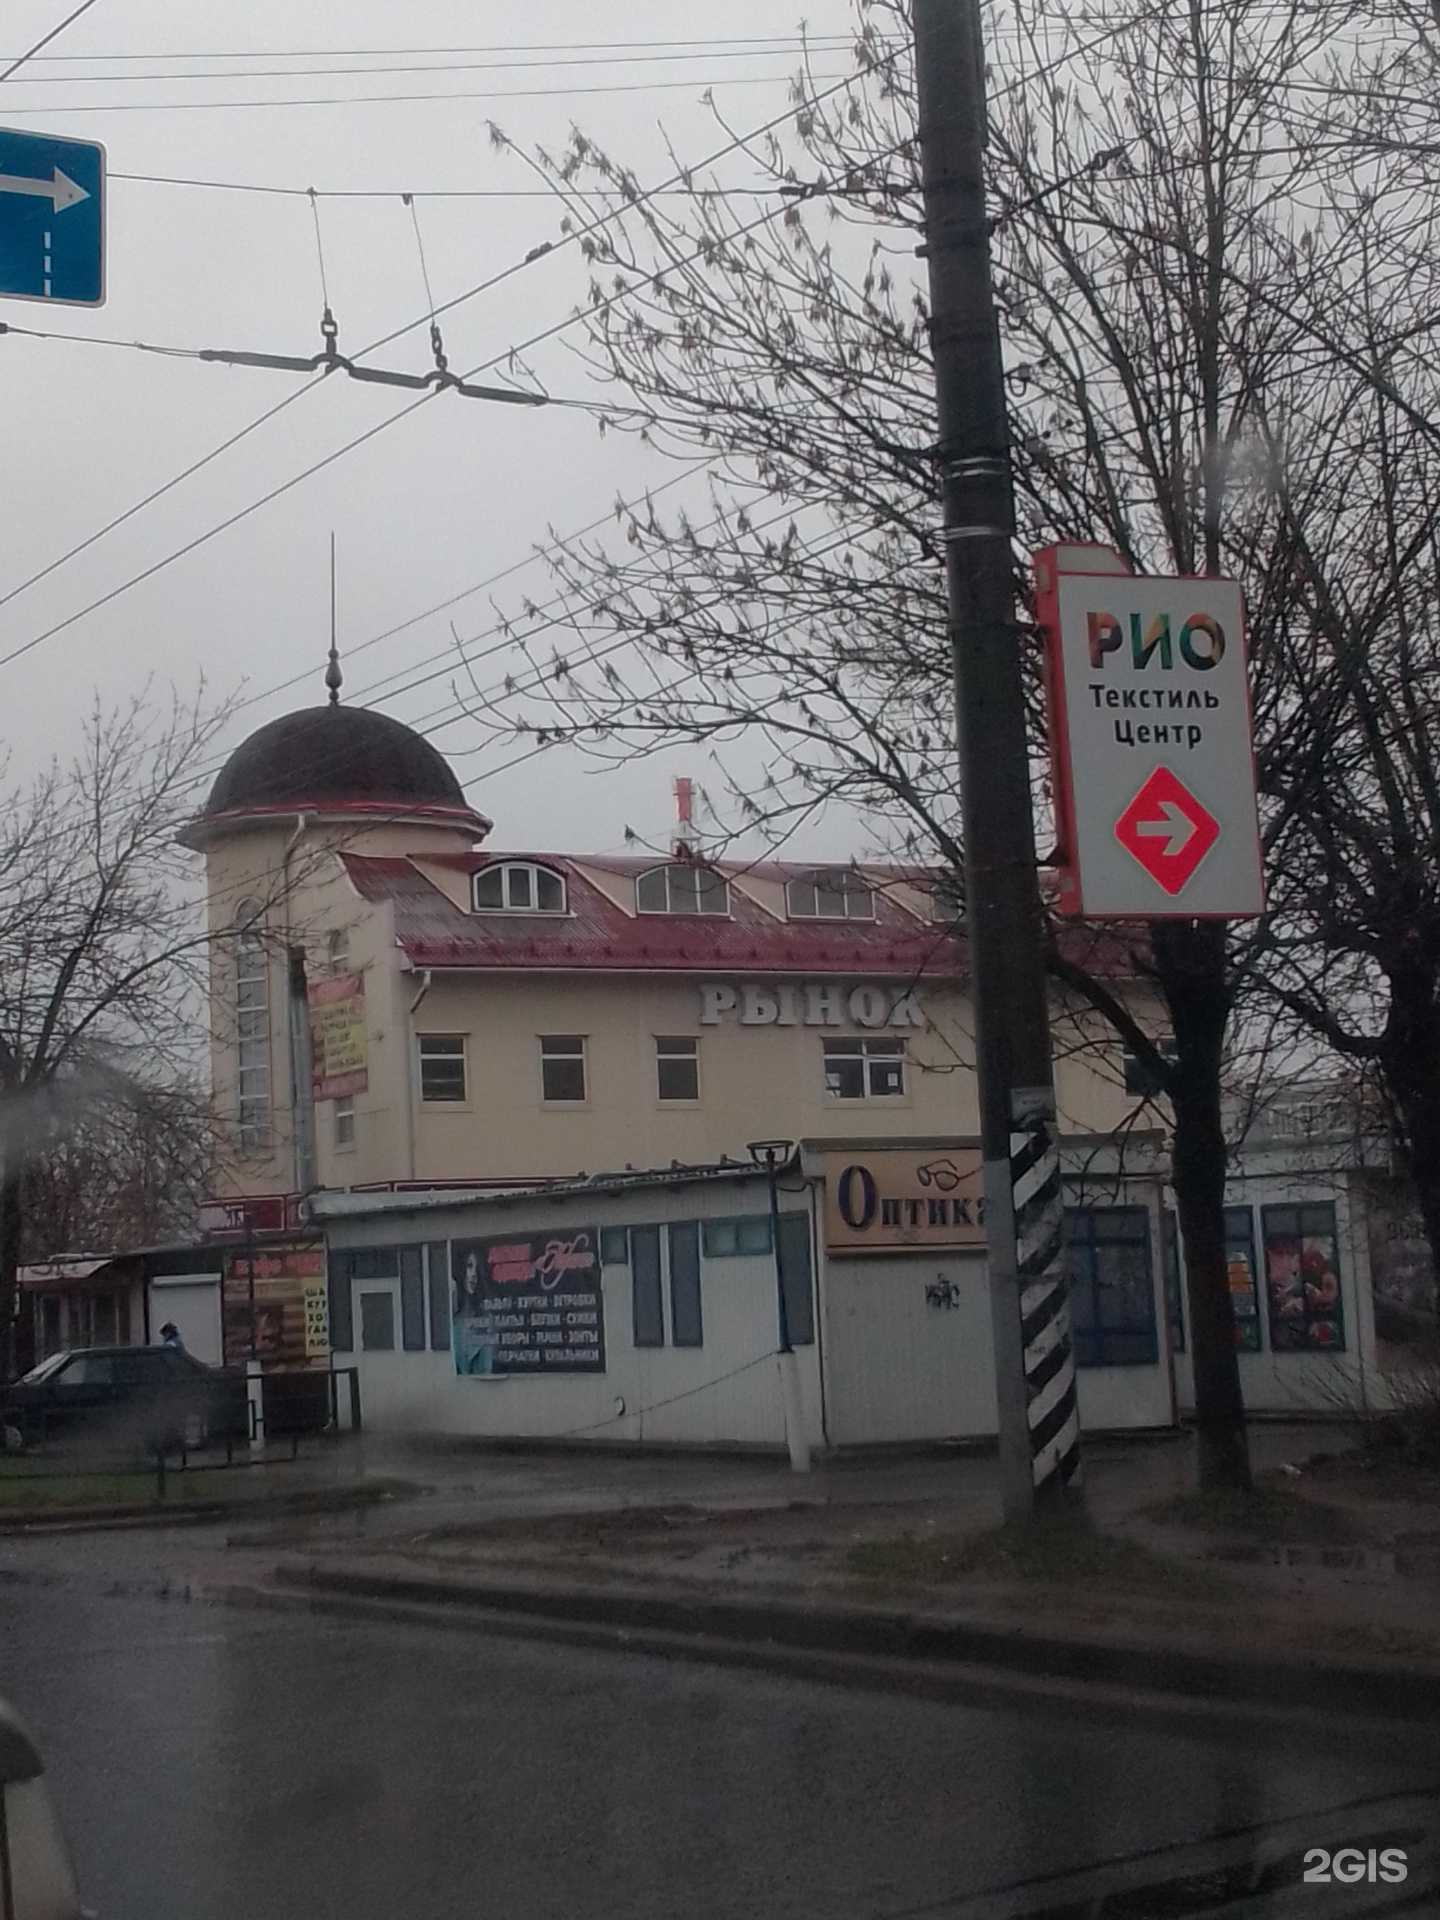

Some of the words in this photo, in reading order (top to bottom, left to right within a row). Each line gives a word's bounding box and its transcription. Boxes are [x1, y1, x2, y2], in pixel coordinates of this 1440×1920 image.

[1086, 611, 1226, 671] РИО
[1088, 684, 1219, 709] Текстиль
[1114, 719, 1202, 749] Центр
[700, 983, 928, 1028] РЫНОК
